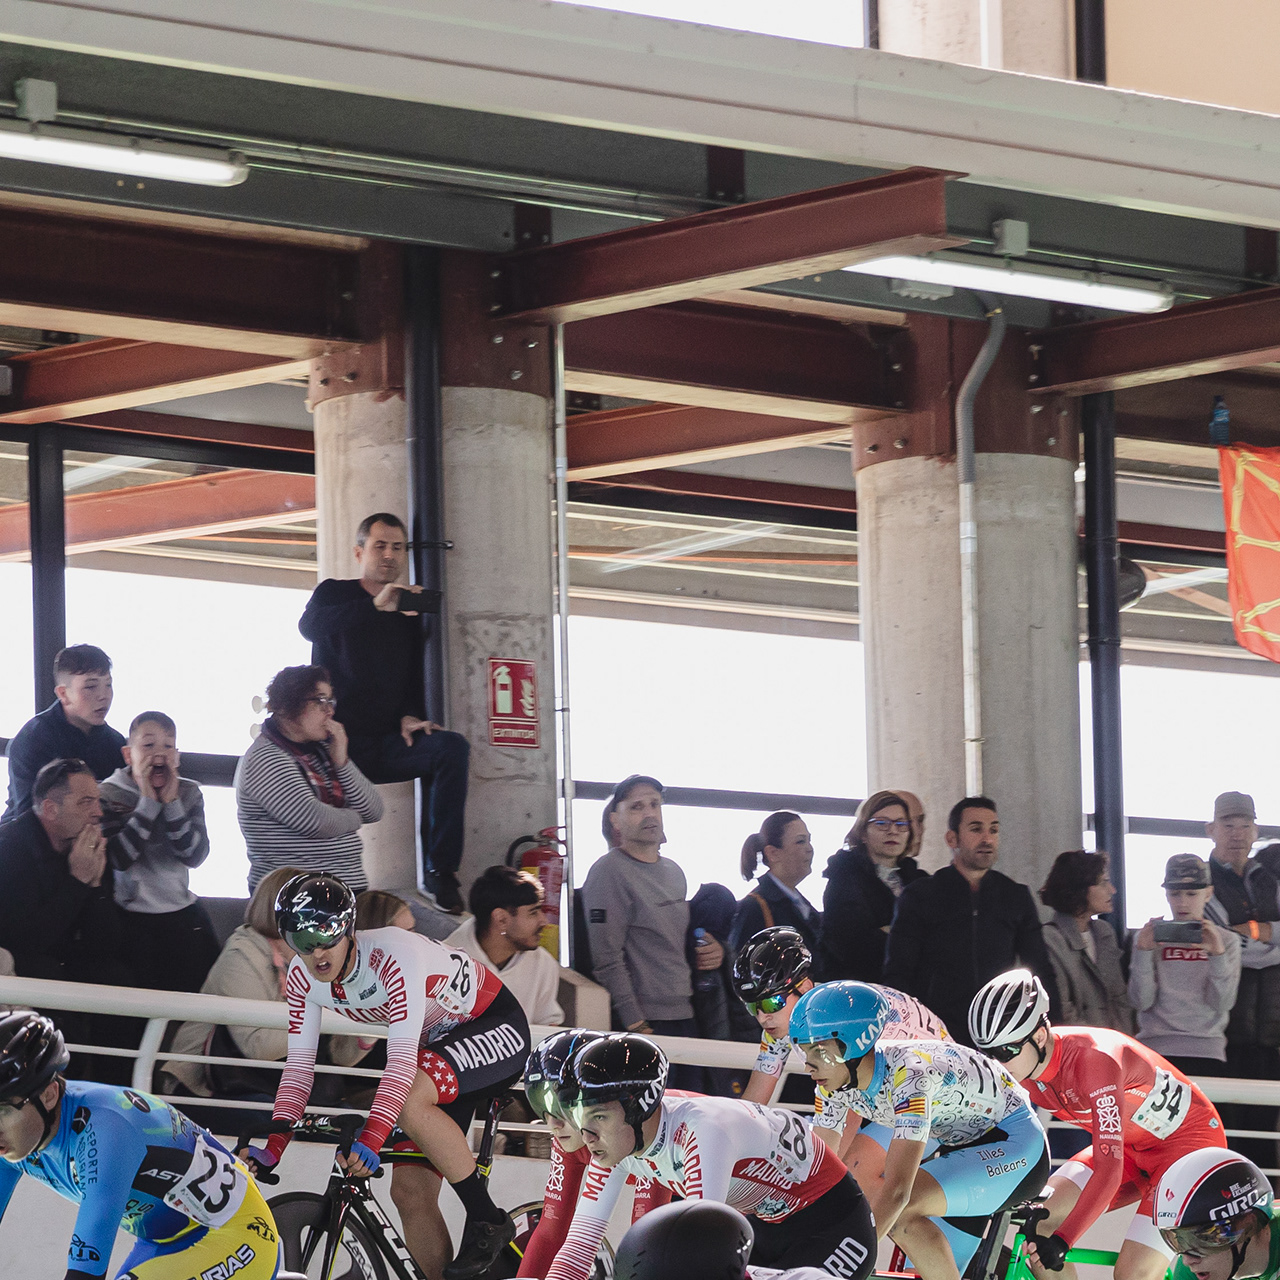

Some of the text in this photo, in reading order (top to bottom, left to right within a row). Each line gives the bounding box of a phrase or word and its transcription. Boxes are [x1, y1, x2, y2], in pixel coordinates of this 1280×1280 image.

[493, 728, 536, 739] EXTINTOR
[378, 953, 408, 1024] MADRID
[444, 1023, 526, 1073] MADRID
[1151, 1074, 1184, 1123] 34
[84, 1122, 99, 1185] DEPORTE
[774, 1110, 808, 1162] 28
[976, 1147, 1006, 1162] Illes
[187, 1149, 237, 1214] 23
[986, 1157, 1028, 1178] Balears
[1209, 1189, 1259, 1221] GIRO
